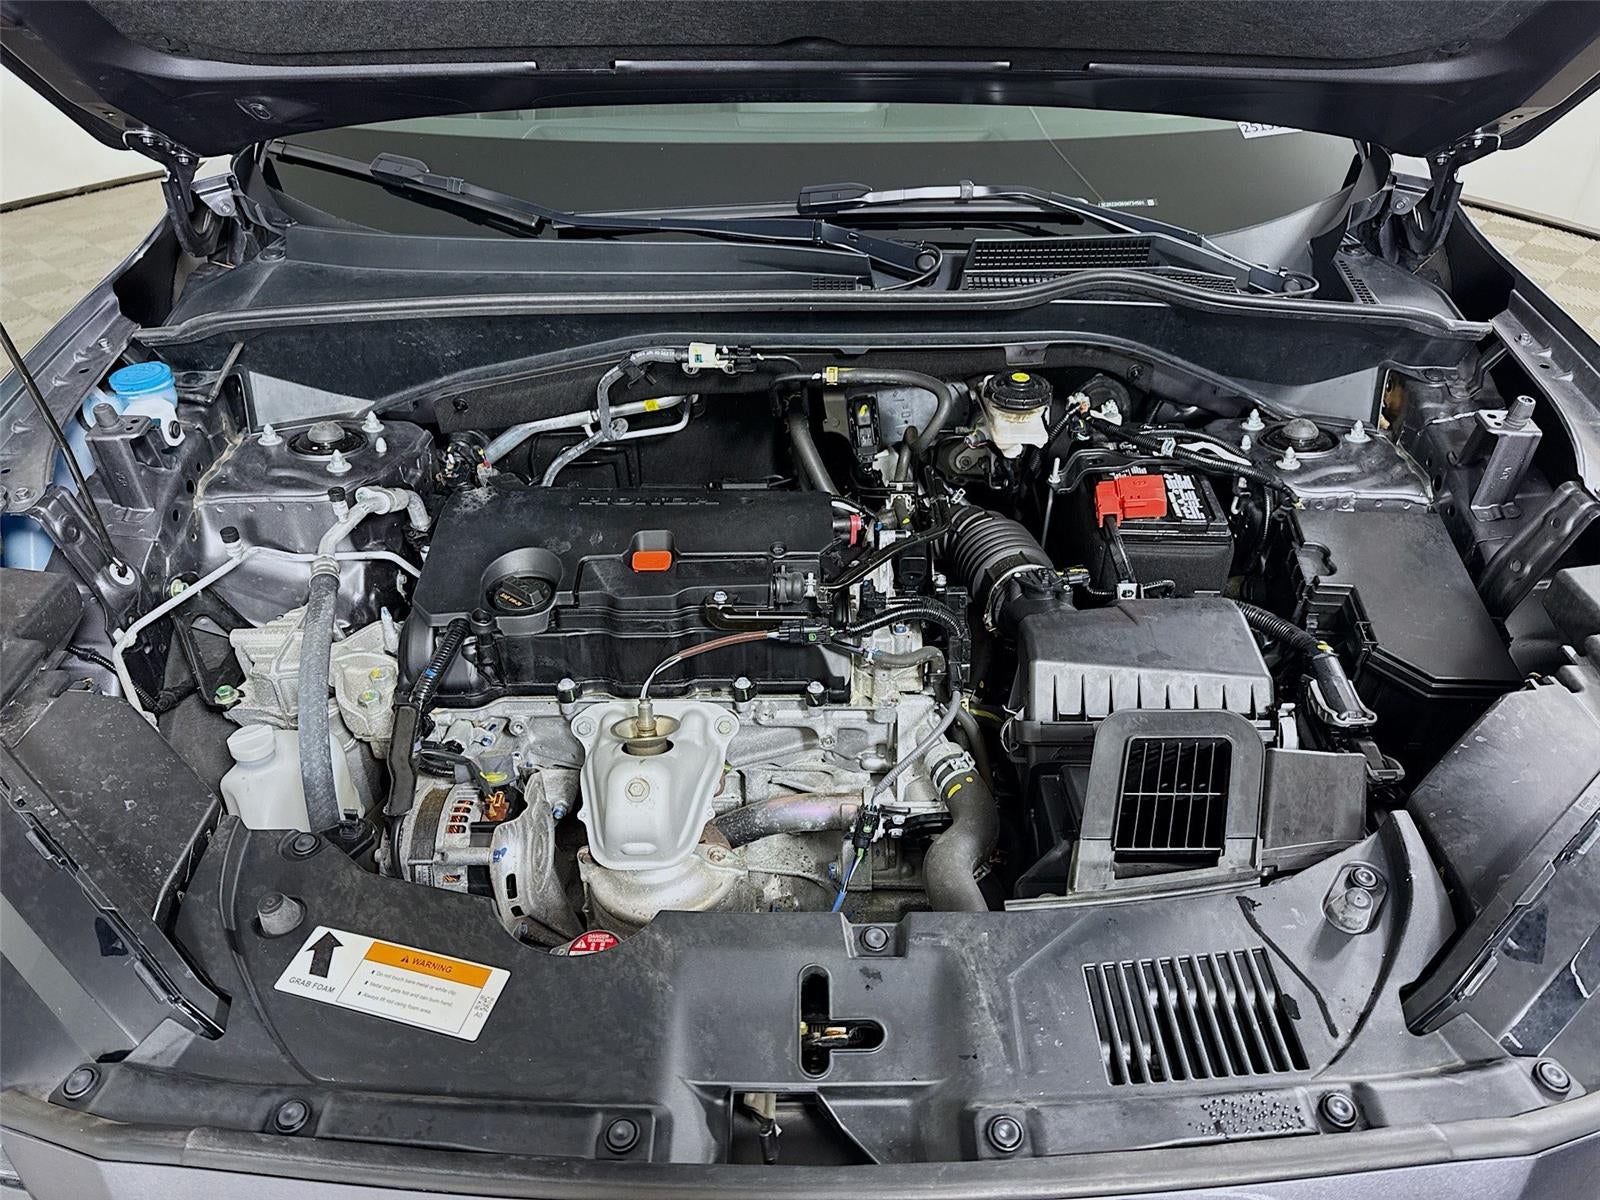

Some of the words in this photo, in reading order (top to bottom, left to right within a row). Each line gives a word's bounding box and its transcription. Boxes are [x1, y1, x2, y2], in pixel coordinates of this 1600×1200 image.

[578, 497, 720, 505] HONDA
[412, 957, 453, 974] WARNING
[289, 976, 312, 988] GRAB
[311, 982, 336, 993] FOAM
[369, 981, 382, 989] Metal
